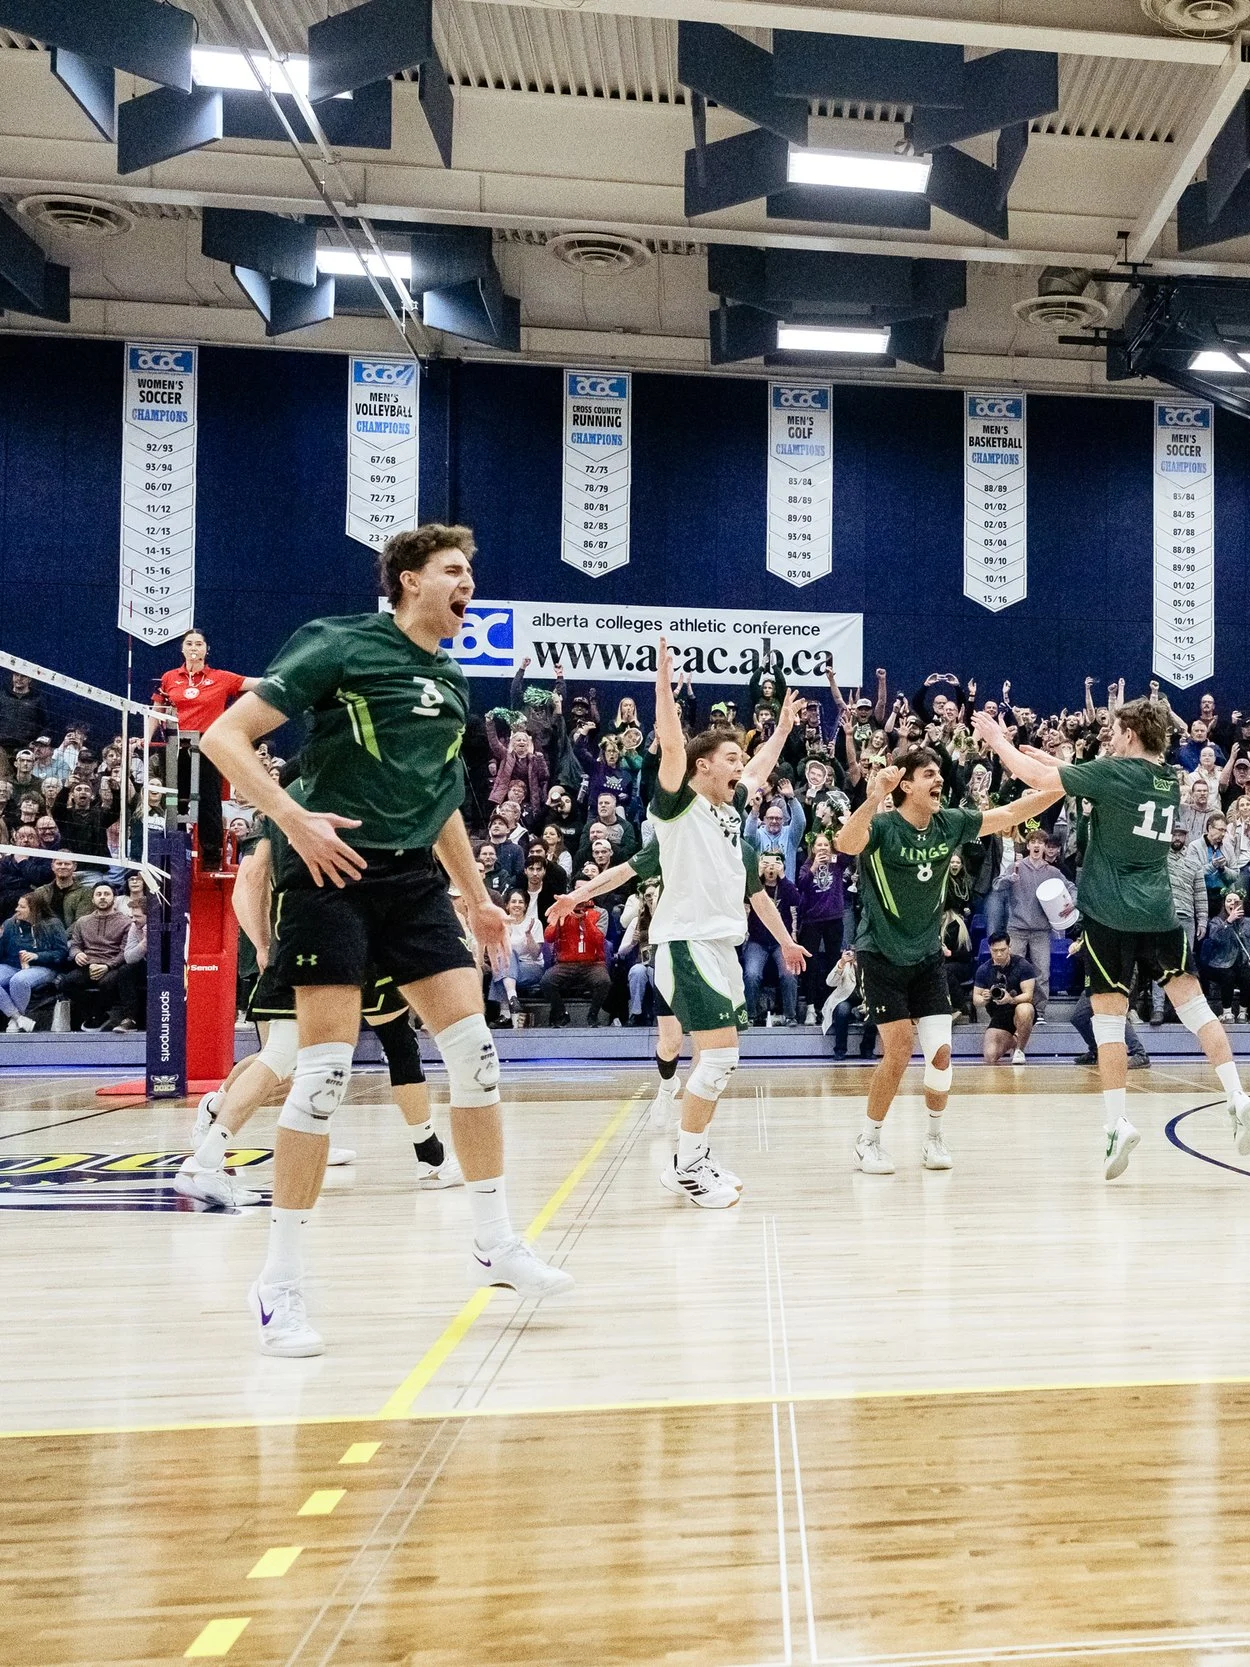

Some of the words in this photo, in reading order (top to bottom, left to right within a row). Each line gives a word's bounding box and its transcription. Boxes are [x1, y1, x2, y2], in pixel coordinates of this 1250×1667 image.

[138, 378, 184, 390] WOMEN'S
[139, 391, 182, 404] SOCCER
[370, 392, 399, 403] MEN'S
[355, 402, 413, 418] VOLLEYBALL
[572, 405, 592, 413] CROSS
[594, 406, 622, 415] COUNTRY
[132, 408, 188, 423] CHAMPIONS
[572, 414, 622, 428] RUNNING
[787, 415, 814, 426] MEN'S
[356, 421, 410, 435] CHAMPIONS
[982, 425, 1008, 435] MEN'S
[788, 427, 813, 439] GOLF
[571, 432, 622, 445] CHAMPIONS
[968, 436, 1022, 449] BASKETBALL
[1171, 434, 1196, 444] MEN'S
[146, 444, 173, 453] 92/93
[776, 443, 825, 457] CHAMPIONS
[1166, 444, 1201, 457] SOCCER
[370, 456, 396, 464] 67/68
[972, 452, 1019, 465] CHAMPIONS
[145, 463, 172, 472] 93/94
[585, 465, 608, 474] 72/73
[1160, 460, 1207, 474] CHAMPIONS
[370, 475, 396, 484] 69/70
[145, 482, 172, 492] 06/07
[584, 484, 608, 493] 78/79
[984, 485, 1007, 493] 88/89
[370, 494, 395, 503] 72/73
[788, 496, 812, 504] 88/89
[146, 505, 171, 513] 11/12
[584, 502, 608, 511] 80/81
[984, 503, 1007, 511] 01/02
[370, 515, 394, 523] 76/77
[787, 514, 812, 523] 89/90
[583, 521, 608, 530] 82/83
[984, 521, 1007, 529] 02/03
[146, 527, 171, 536] 12/13
[1173, 528, 1195, 536] 87/88
[787, 533, 811, 541] 93/94
[583, 540, 608, 549] 86/87
[984, 539, 1007, 547] 03/04
[145, 547, 171, 556] 14-15
[787, 551, 811, 560] 94/95
[582, 560, 608, 569] 89/90
[984, 557, 1007, 565] 09/10
[145, 566, 170, 575] 15-16
[1172, 564, 1195, 572] 89/90
[787, 570, 811, 579] 03/04
[985, 575, 1006, 583] 10/11
[1173, 581, 1195, 590] 01/02
[144, 586, 170, 595] 16-17
[983, 595, 1007, 603] 15/16
[143, 606, 170, 616] 18-19
[532, 613, 589, 629] alberta
[595, 615, 662, 633] colleges
[669, 617, 726, 633] athletic
[733, 620, 821, 637] conference
[1174, 617, 1194, 625] 10/11
[142, 627, 169, 637] 19-20
[1174, 636, 1194, 644] 11/12
[1172, 652, 1195, 661] 14/15
[1172, 672, 1194, 681] 18-19
[411, 676, 444, 716] 3
[1132, 800, 1175, 842] 11
[900, 843, 949, 861] KINGS
[917, 862, 933, 882] 8
[160, 991, 171, 1022] sports
[160, 1024, 171, 1062] imports
